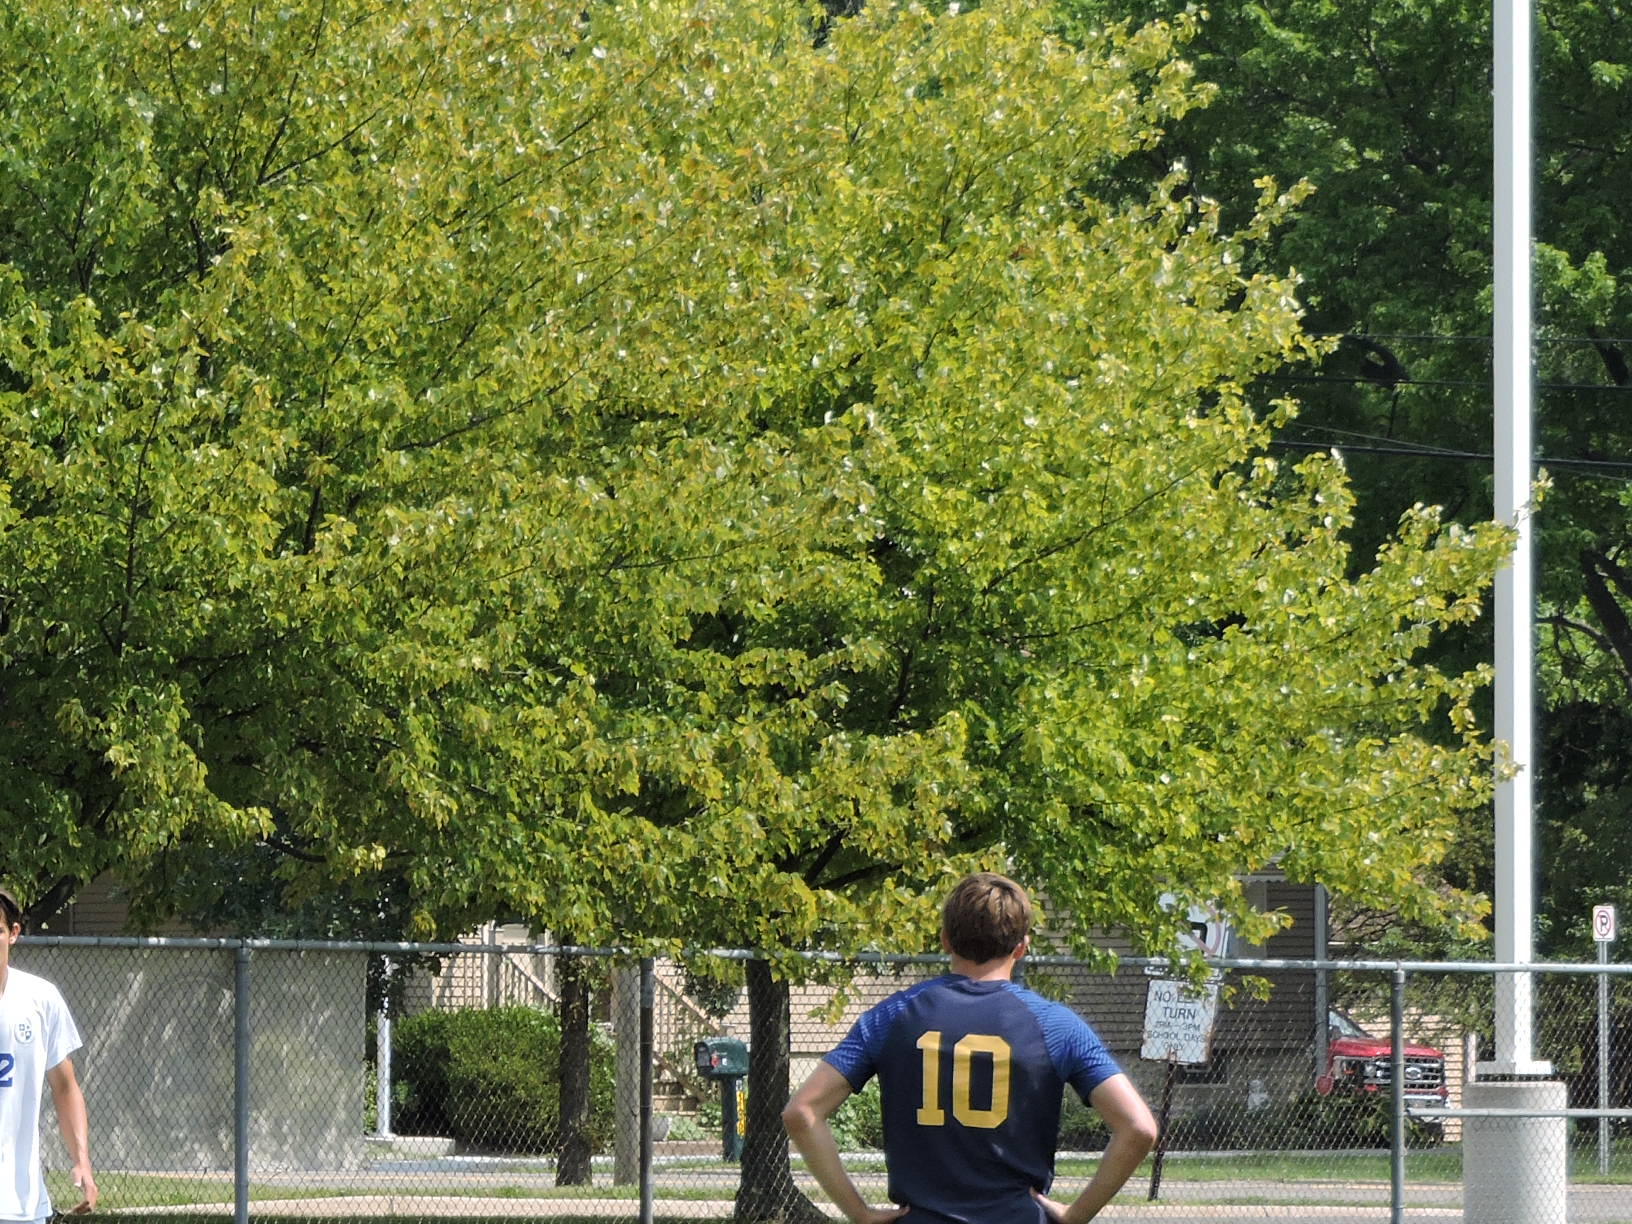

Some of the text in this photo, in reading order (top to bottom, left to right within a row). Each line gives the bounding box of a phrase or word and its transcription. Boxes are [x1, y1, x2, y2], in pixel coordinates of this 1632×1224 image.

[1154, 990, 1171, 1003] NO
[1163, 1006, 1197, 1020] TURN
[1147, 1030, 1180, 1041] SCHOOL
[916, 1030, 1011, 1129] 10
